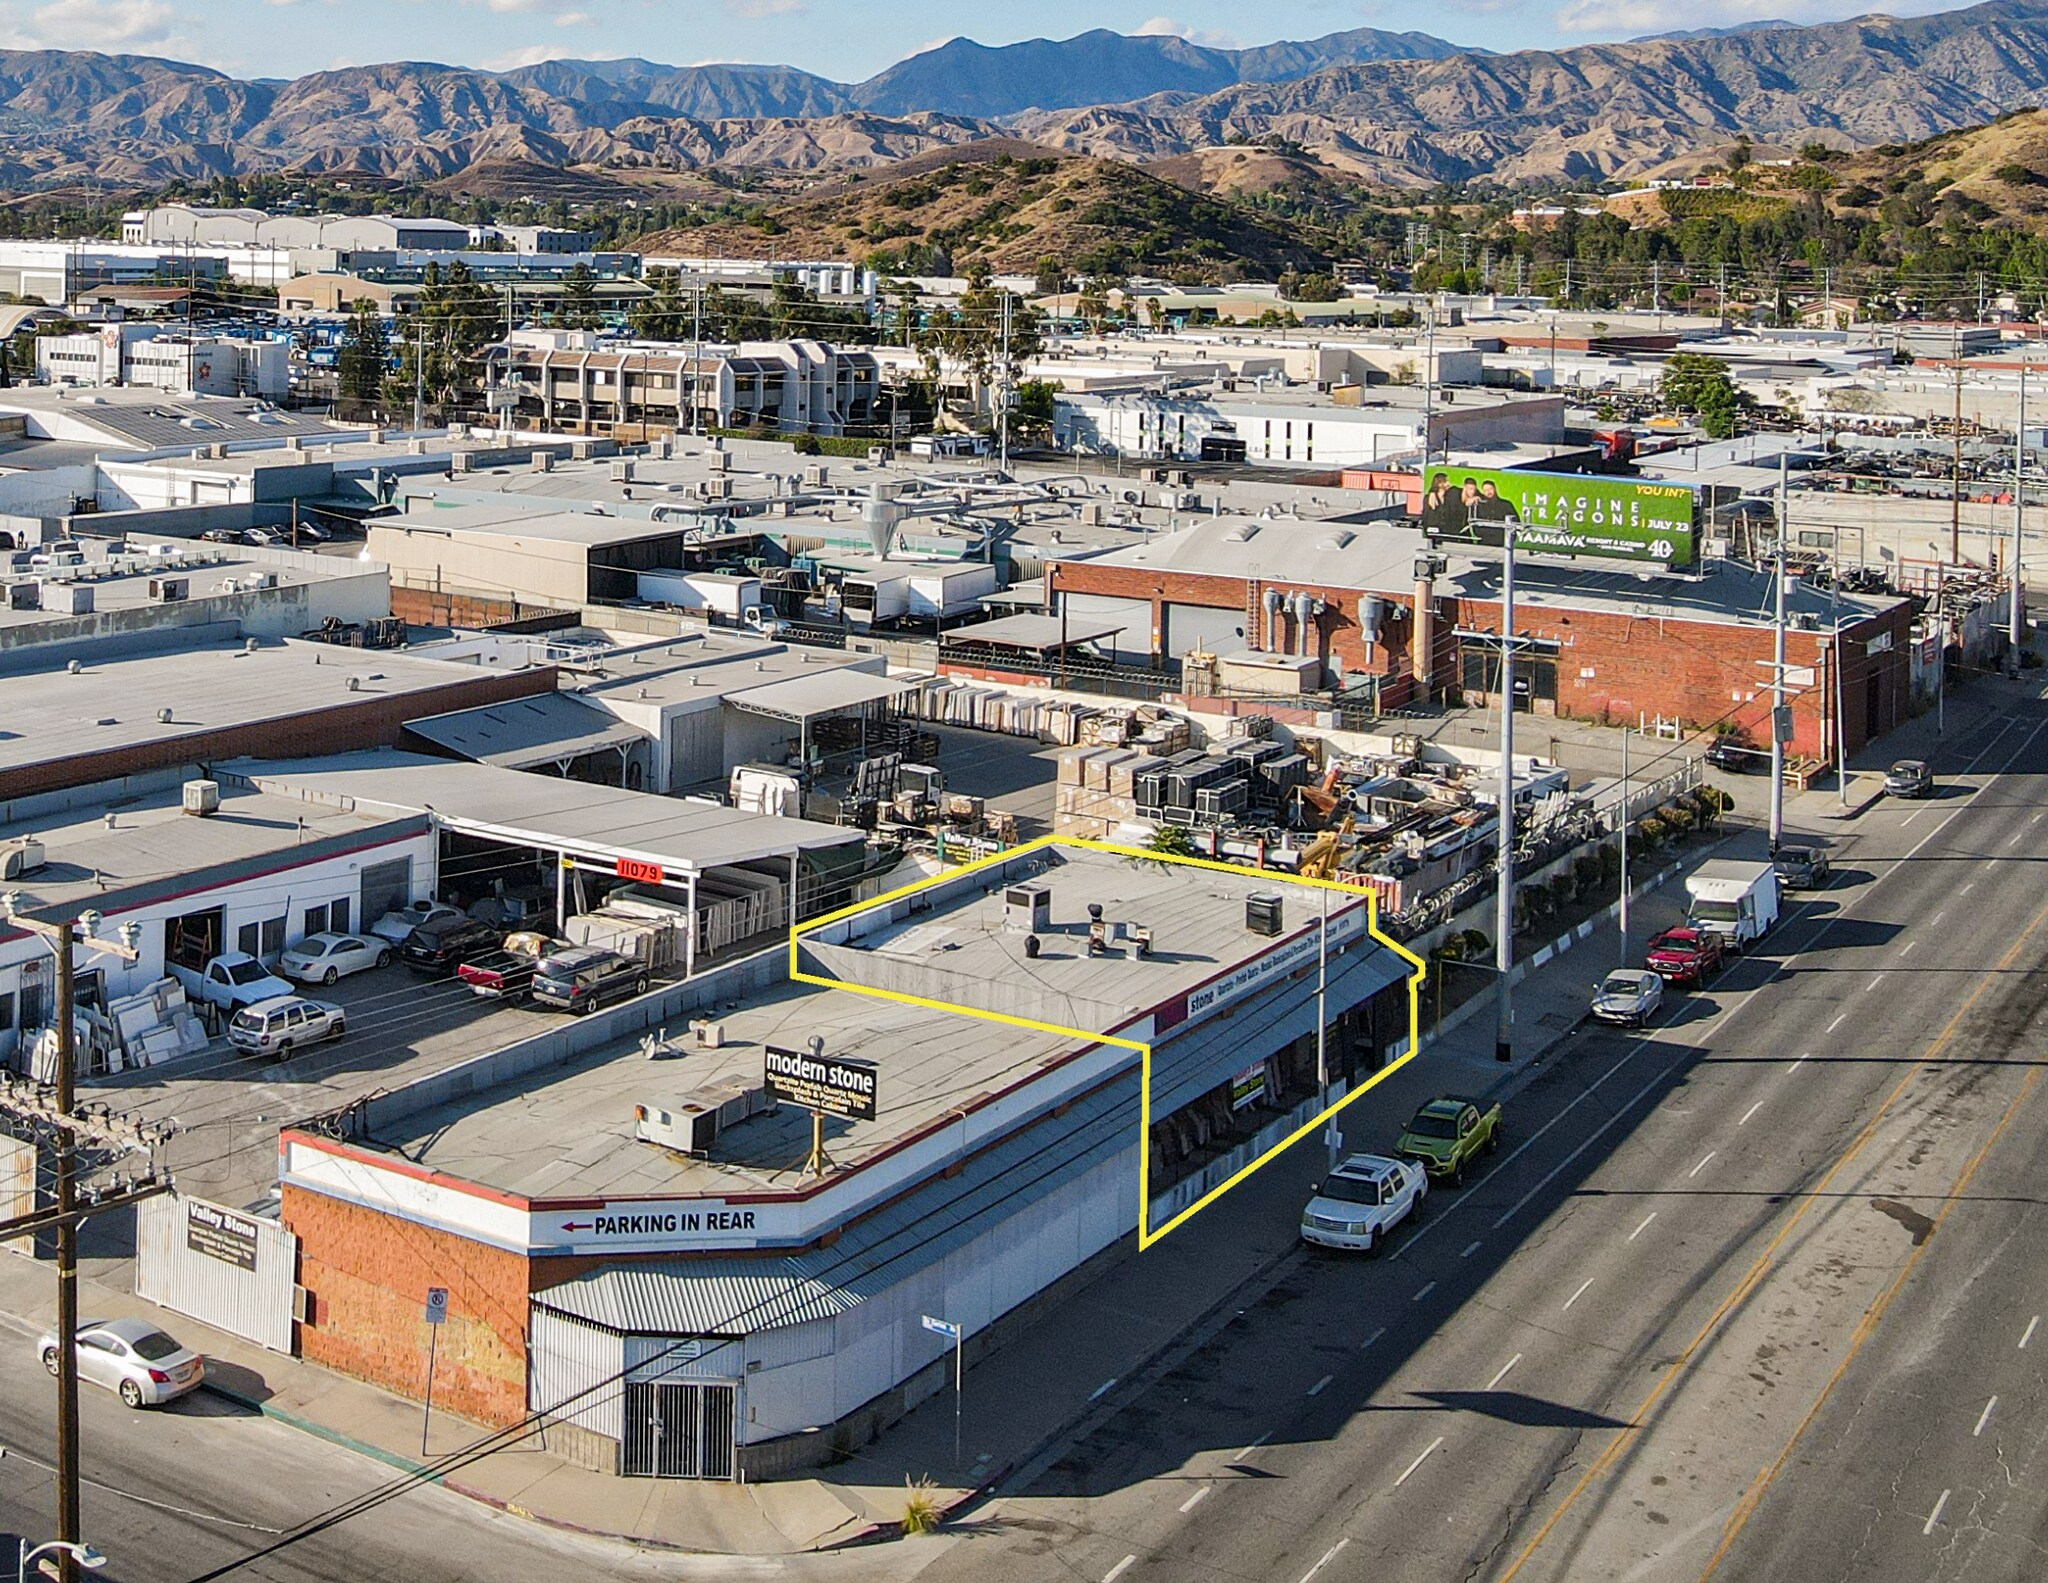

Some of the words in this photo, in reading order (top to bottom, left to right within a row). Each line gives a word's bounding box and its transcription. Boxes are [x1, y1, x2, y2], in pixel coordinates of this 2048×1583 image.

[1522, 492, 1640, 513] IMAGINE
[1636, 485, 1662, 496] YOU
[1664, 487, 1686, 499] IN?
[1521, 506, 1640, 528] DRAGONS
[1647, 519, 1672, 530] JULY
[1675, 521, 1690, 532] 23
[620, 860, 658, 880] 11079
[1190, 990, 1215, 1013] stone
[766, 1052, 827, 1083] modern
[828, 1064, 873, 1094] stone
[189, 1202, 223, 1229] Valley
[224, 1215, 256, 1238] Stone
[595, 1214, 677, 1235] PARKING
[681, 1213, 700, 1232] IN
[706, 1211, 756, 1231] REAR
